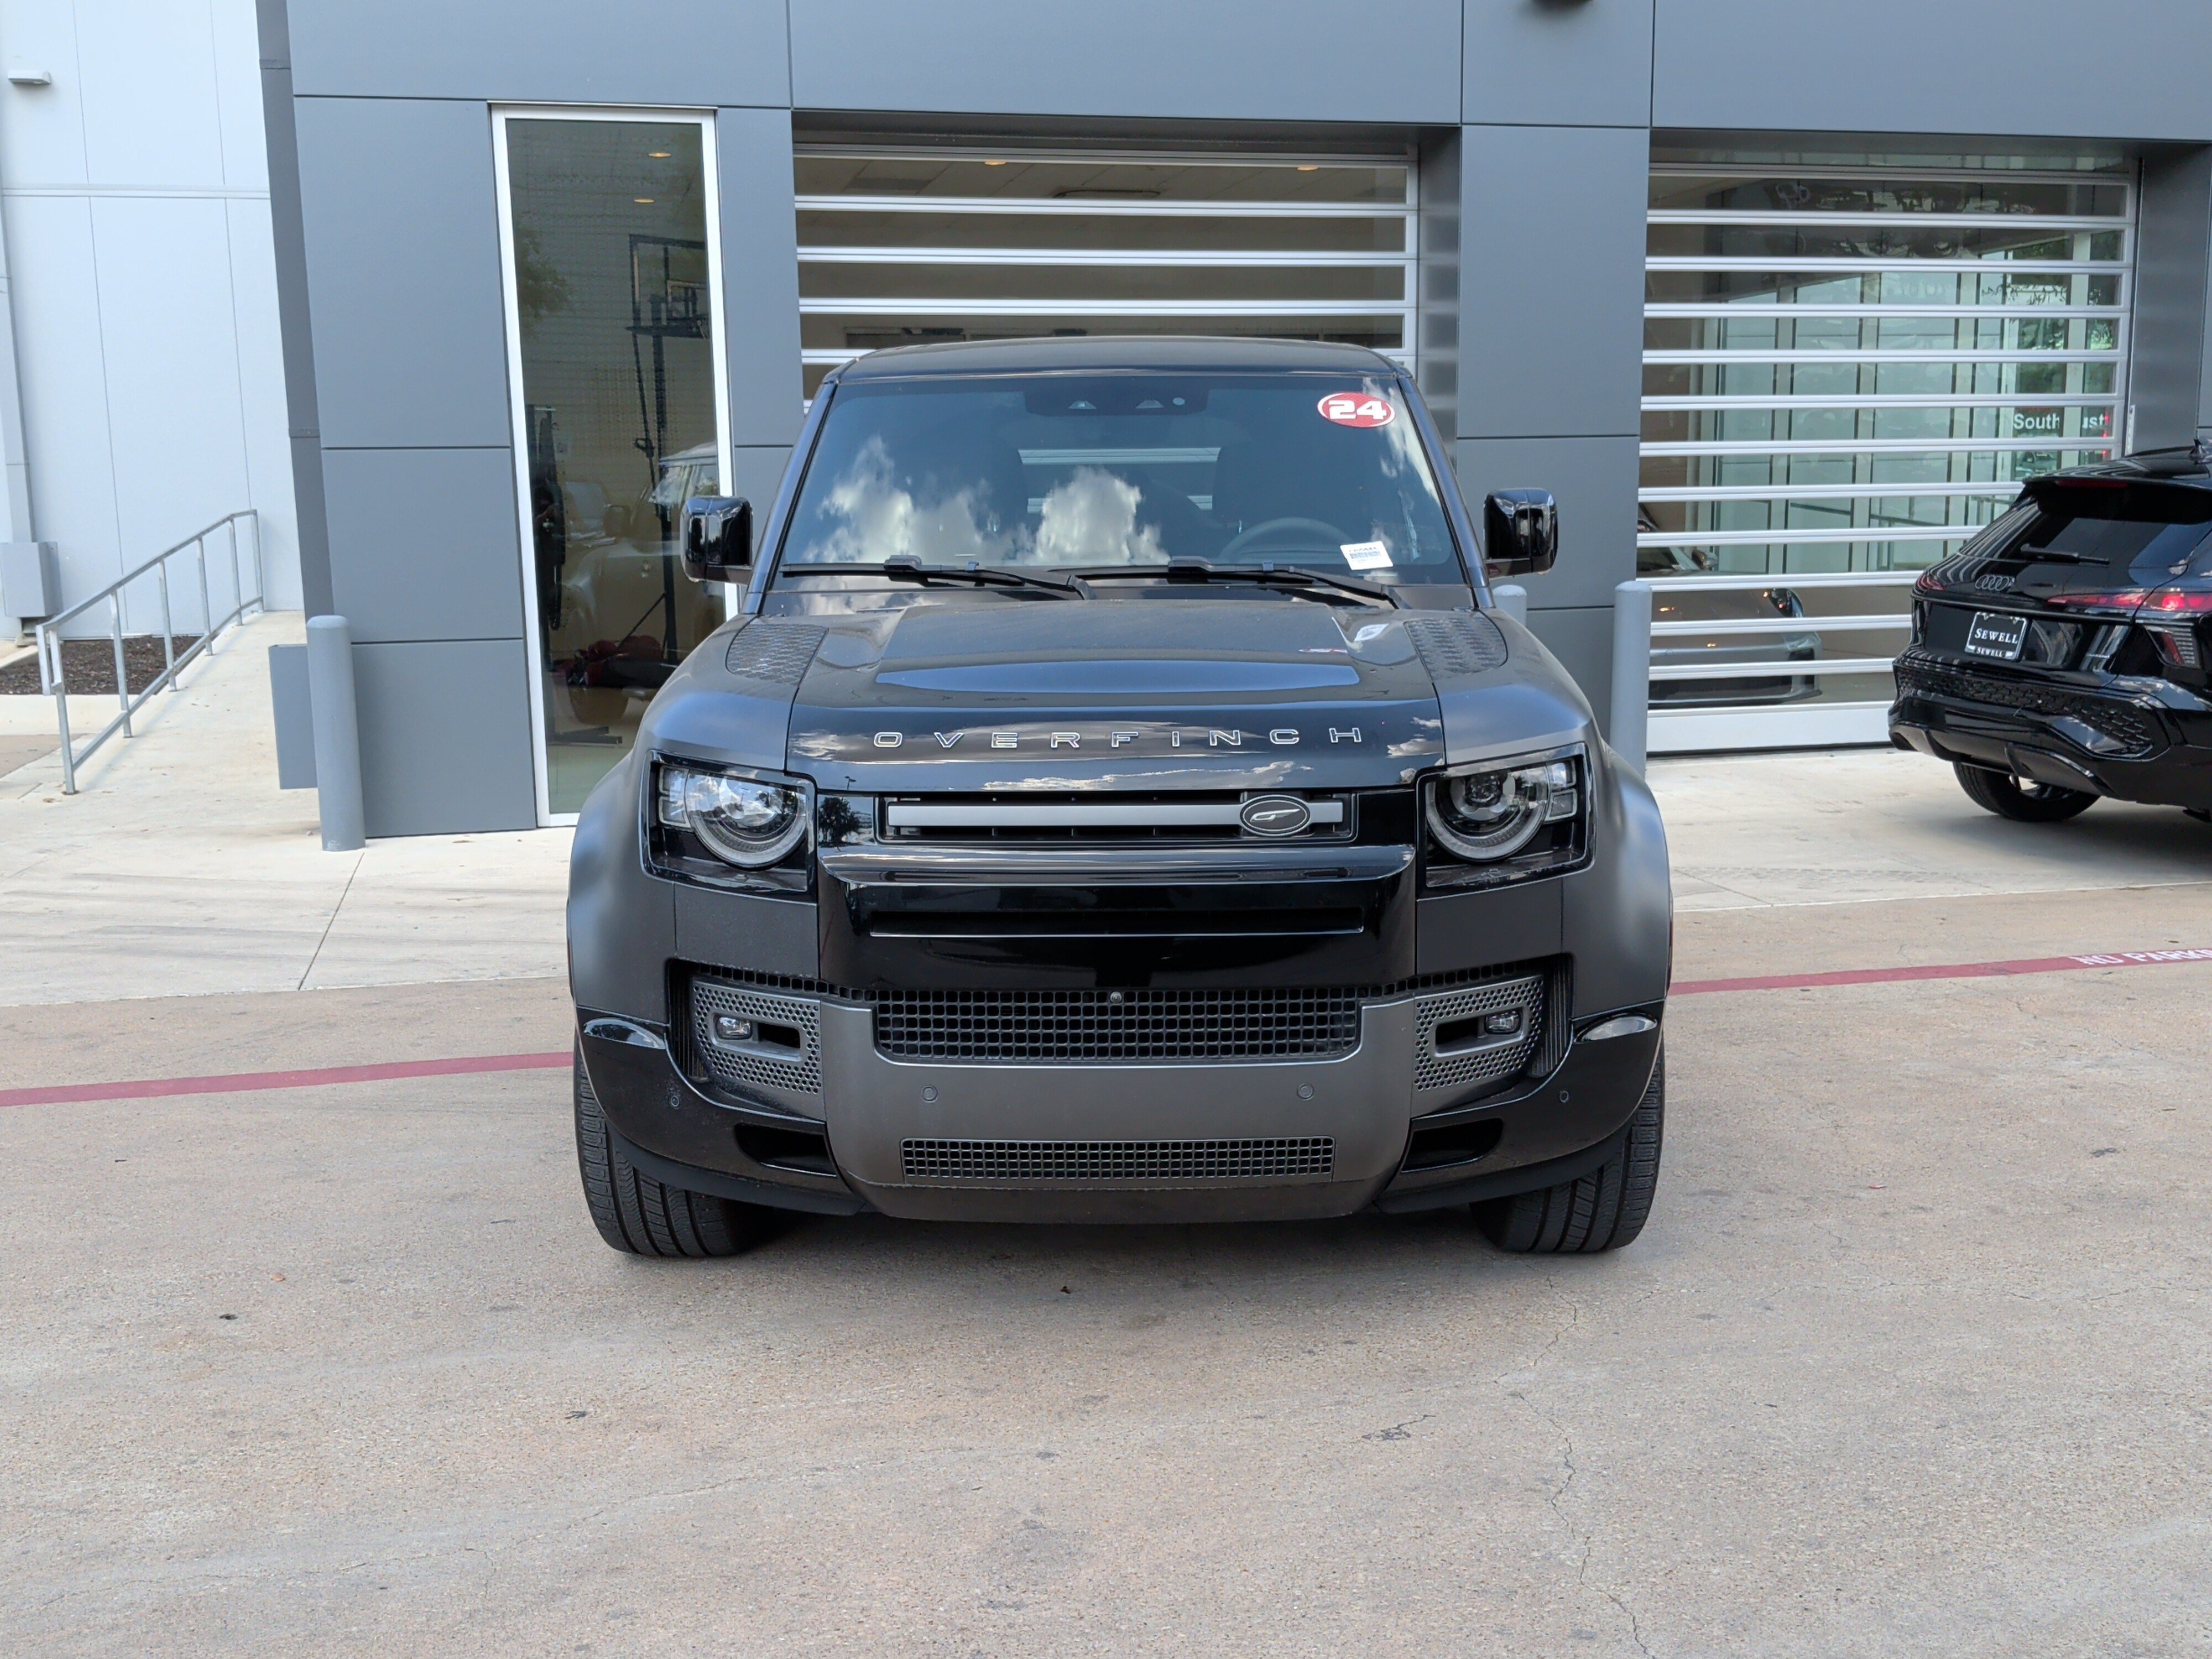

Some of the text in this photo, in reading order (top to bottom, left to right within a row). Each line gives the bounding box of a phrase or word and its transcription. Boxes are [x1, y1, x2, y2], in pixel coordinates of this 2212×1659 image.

[1328, 400, 1387, 420] 24
[1975, 628, 2018, 644] SEWELL
[1976, 646, 2002, 657] SEWELL
[873, 727, 1362, 749] OVERFINCH
[2068, 954, 2124, 966] NO
